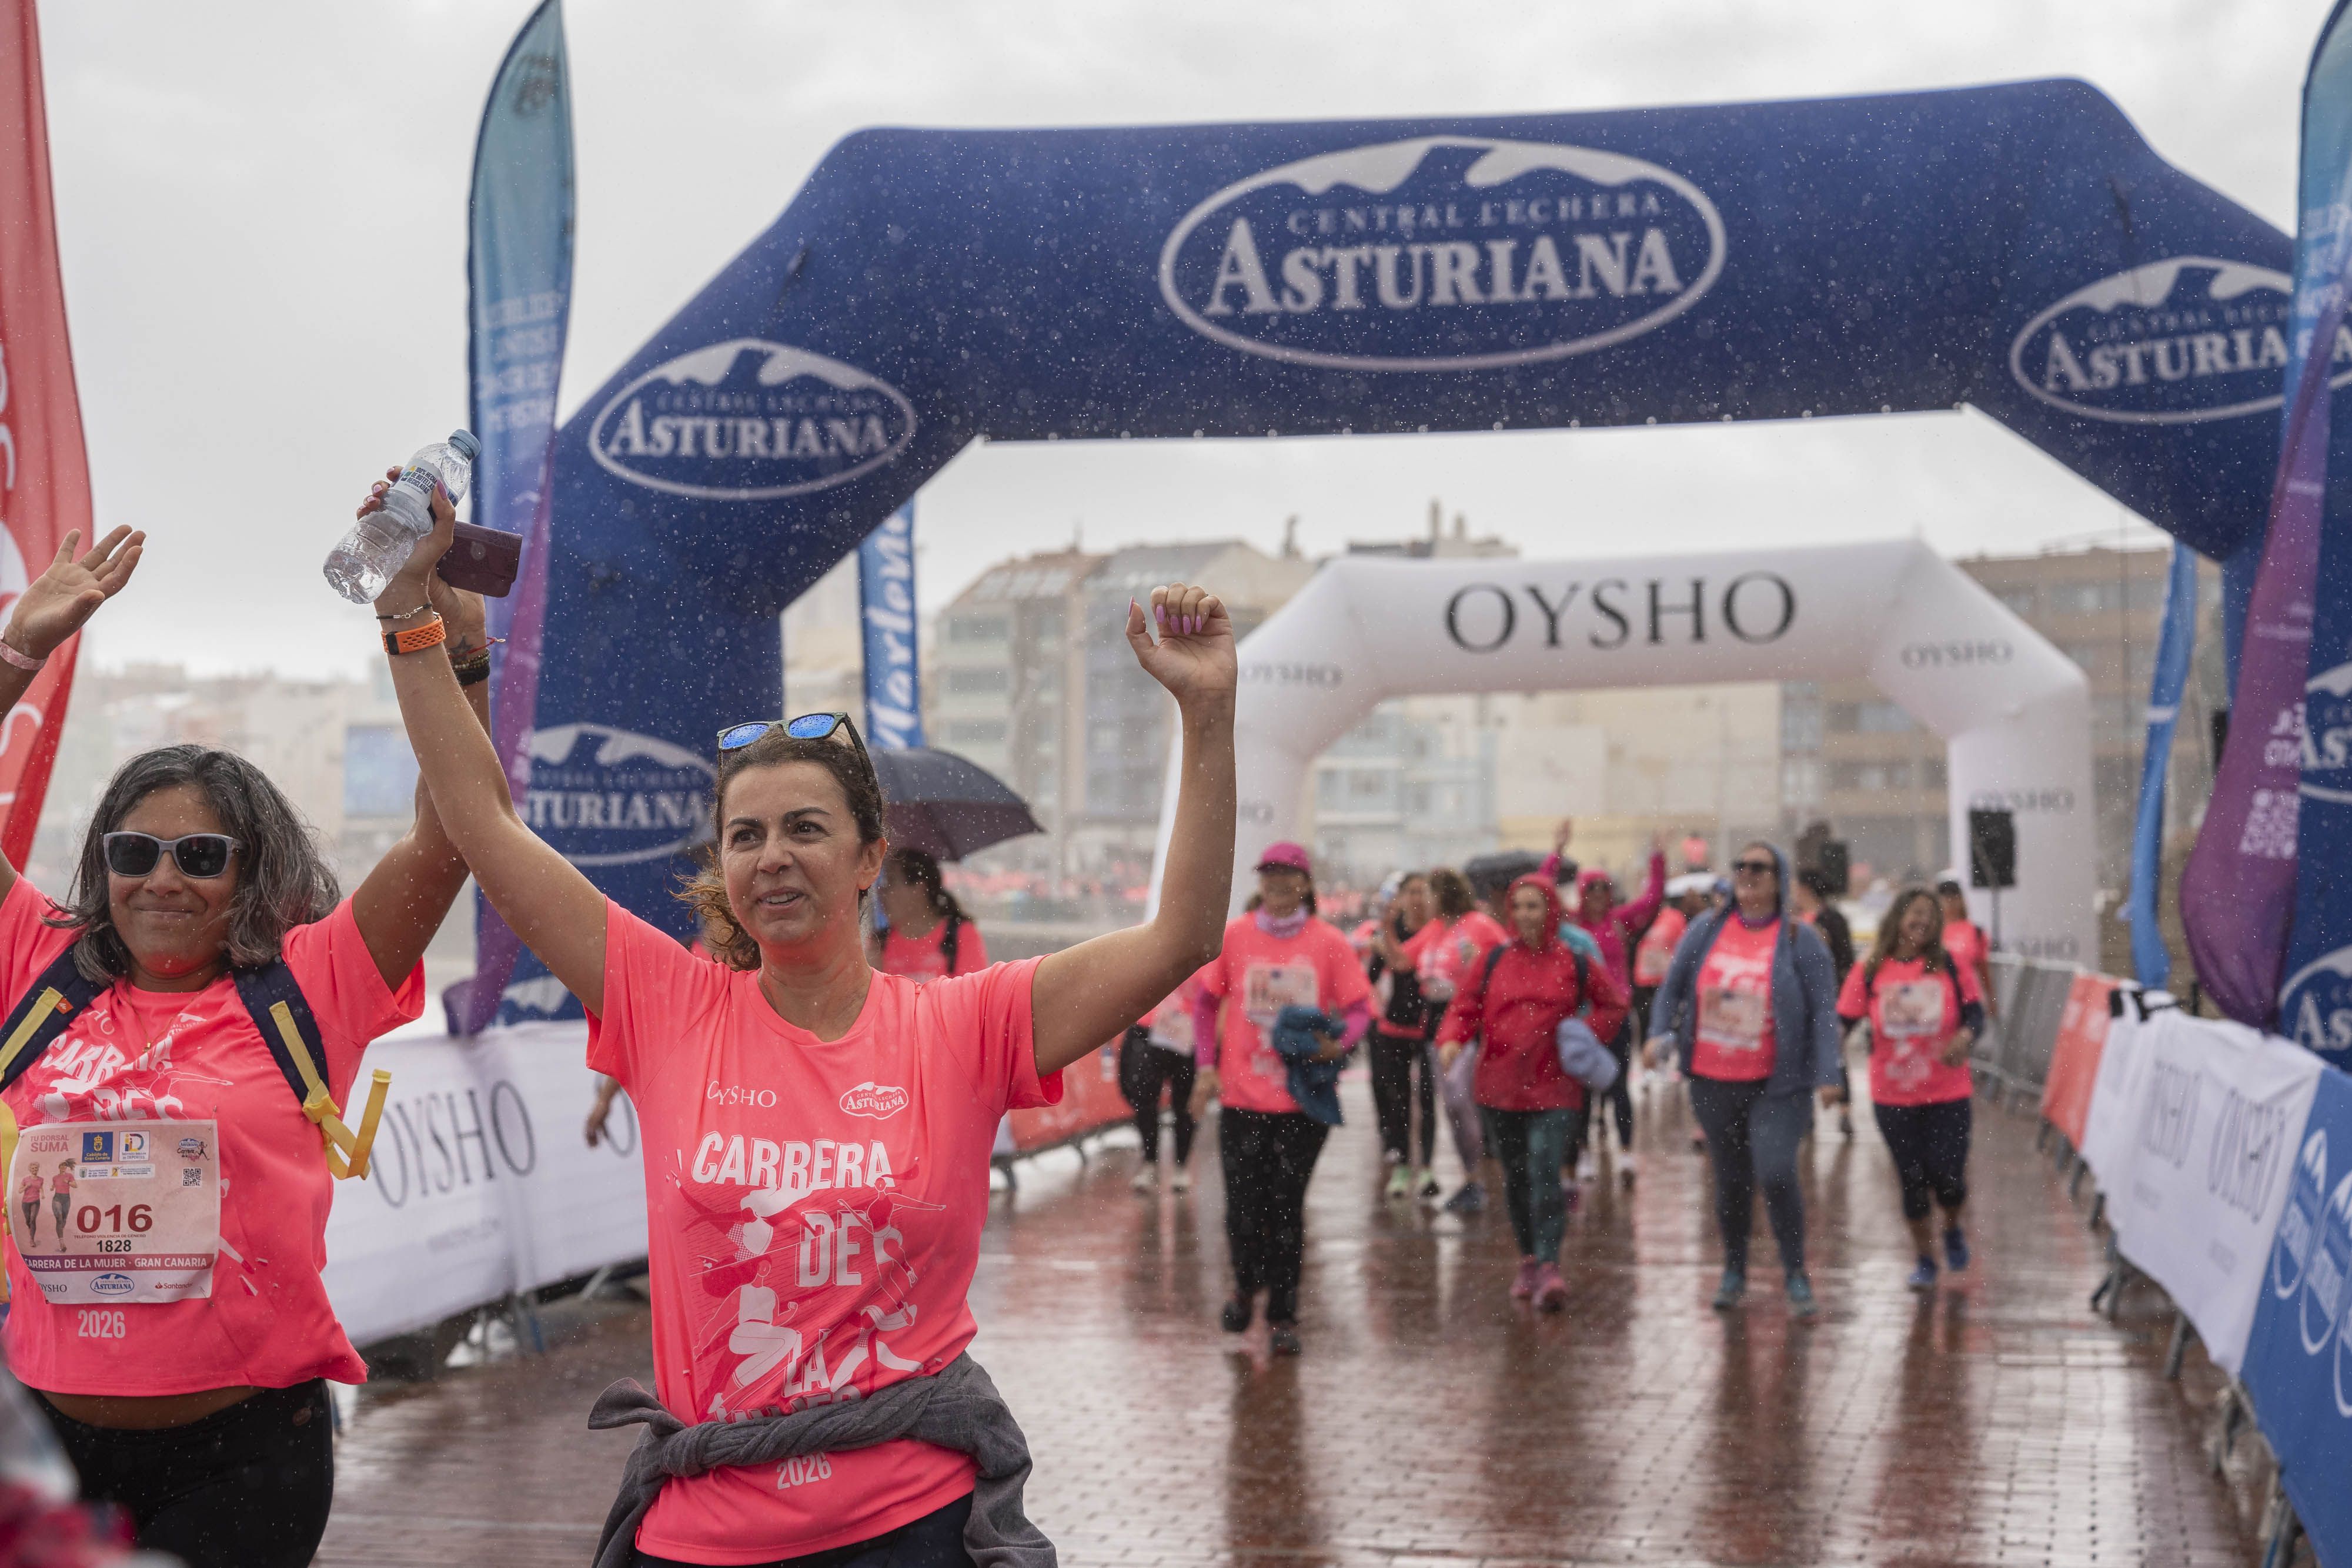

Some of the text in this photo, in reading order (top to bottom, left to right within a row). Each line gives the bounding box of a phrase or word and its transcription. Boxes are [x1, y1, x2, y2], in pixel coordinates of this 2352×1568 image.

[1287, 193, 1662, 234] CENTRAL LECHERA
[1204, 216, 1685, 316] ASTURIANA
[2046, 325, 2352, 392] ASTURIAA
[607, 397, 888, 459] ASTURIANA
[406, 477, 430, 494] RECICLADAS
[415, 467, 426, 475] 100%
[416, 474, 435, 490] BOTELLAS
[1444, 569, 1798, 654] OYSHO
[527, 790, 709, 828] TURIANA
[846, 1096, 904, 1111] ASTURIANA
[31, 1141, 69, 1152] SUMA
[370, 1079, 536, 1208] OYSHO
[691, 1131, 896, 1193] CARRERA
[77, 1203, 153, 1233] 016
[64, 1259, 76, 1268] DE
[79, 1259, 91, 1268] LA
[94, 1258, 126, 1268] MUJER
[135, 1258, 161, 1267] GRAN
[165, 1258, 207, 1266] CANARIA
[96, 1239, 132, 1252] 1828
[795, 1209, 869, 1287] DE
[94, 1281, 131, 1289] ASTURIANA
[78, 1309, 125, 1339] 2026
[781, 1329, 831, 1398] LA
[777, 1453, 832, 1490] 2026
